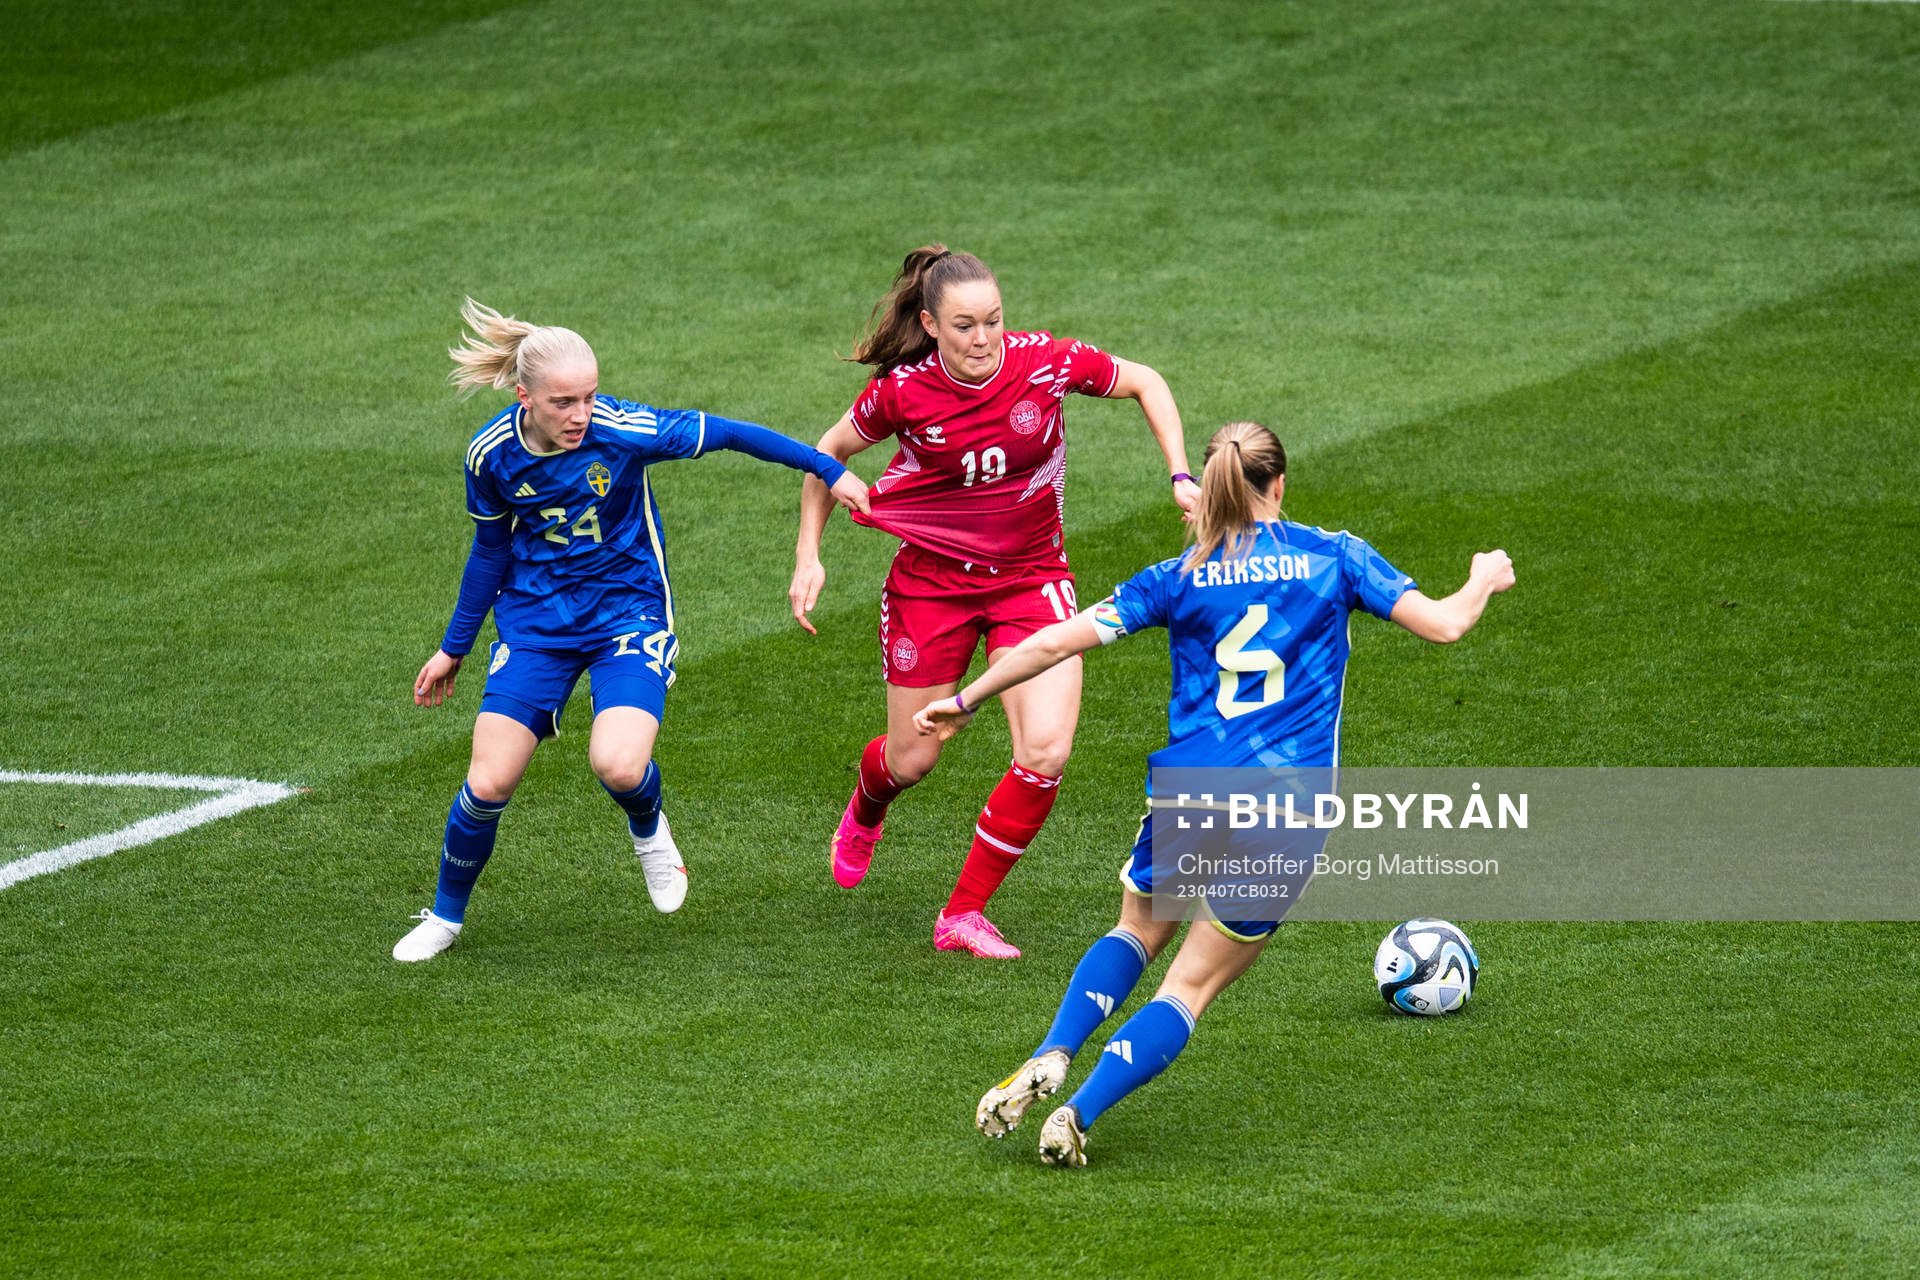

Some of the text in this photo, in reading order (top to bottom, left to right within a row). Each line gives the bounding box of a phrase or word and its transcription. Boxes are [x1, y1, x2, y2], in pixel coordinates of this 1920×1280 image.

[960, 446, 1006, 487] 19
[539, 506, 602, 545] 24
[1193, 554, 1310, 588] ERIKSSON
[1041, 579, 1077, 620] 19
[1215, 604, 1285, 720] 6
